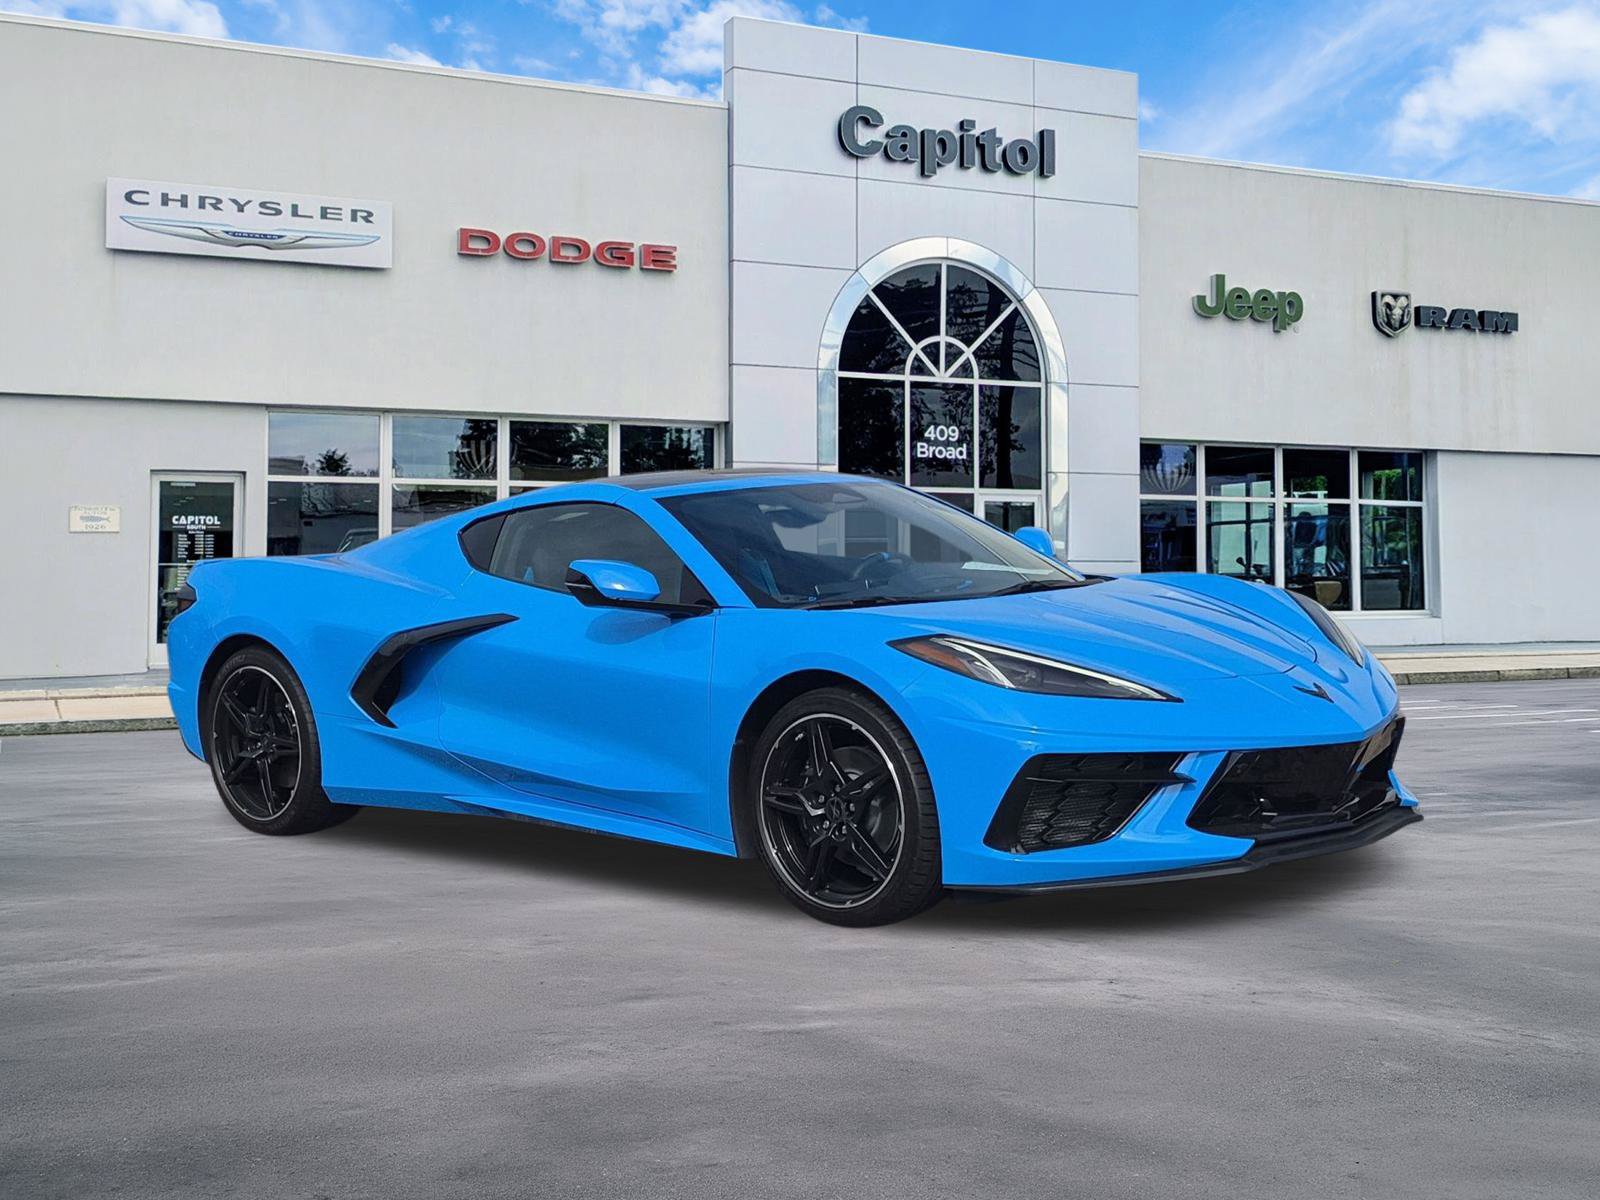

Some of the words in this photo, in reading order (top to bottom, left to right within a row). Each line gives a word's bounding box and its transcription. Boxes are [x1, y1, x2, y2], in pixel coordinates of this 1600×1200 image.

[838, 105, 1056, 177] Capitol
[124, 190, 375, 224] CHRYSLER
[457, 227, 678, 272] DODGE
[1192, 273, 1304, 333] Jeep
[1414, 304, 1519, 334] RAM
[924, 425, 959, 441] 409
[917, 442, 967, 459] Broad
[172, 515, 221, 525] CAPITOL
